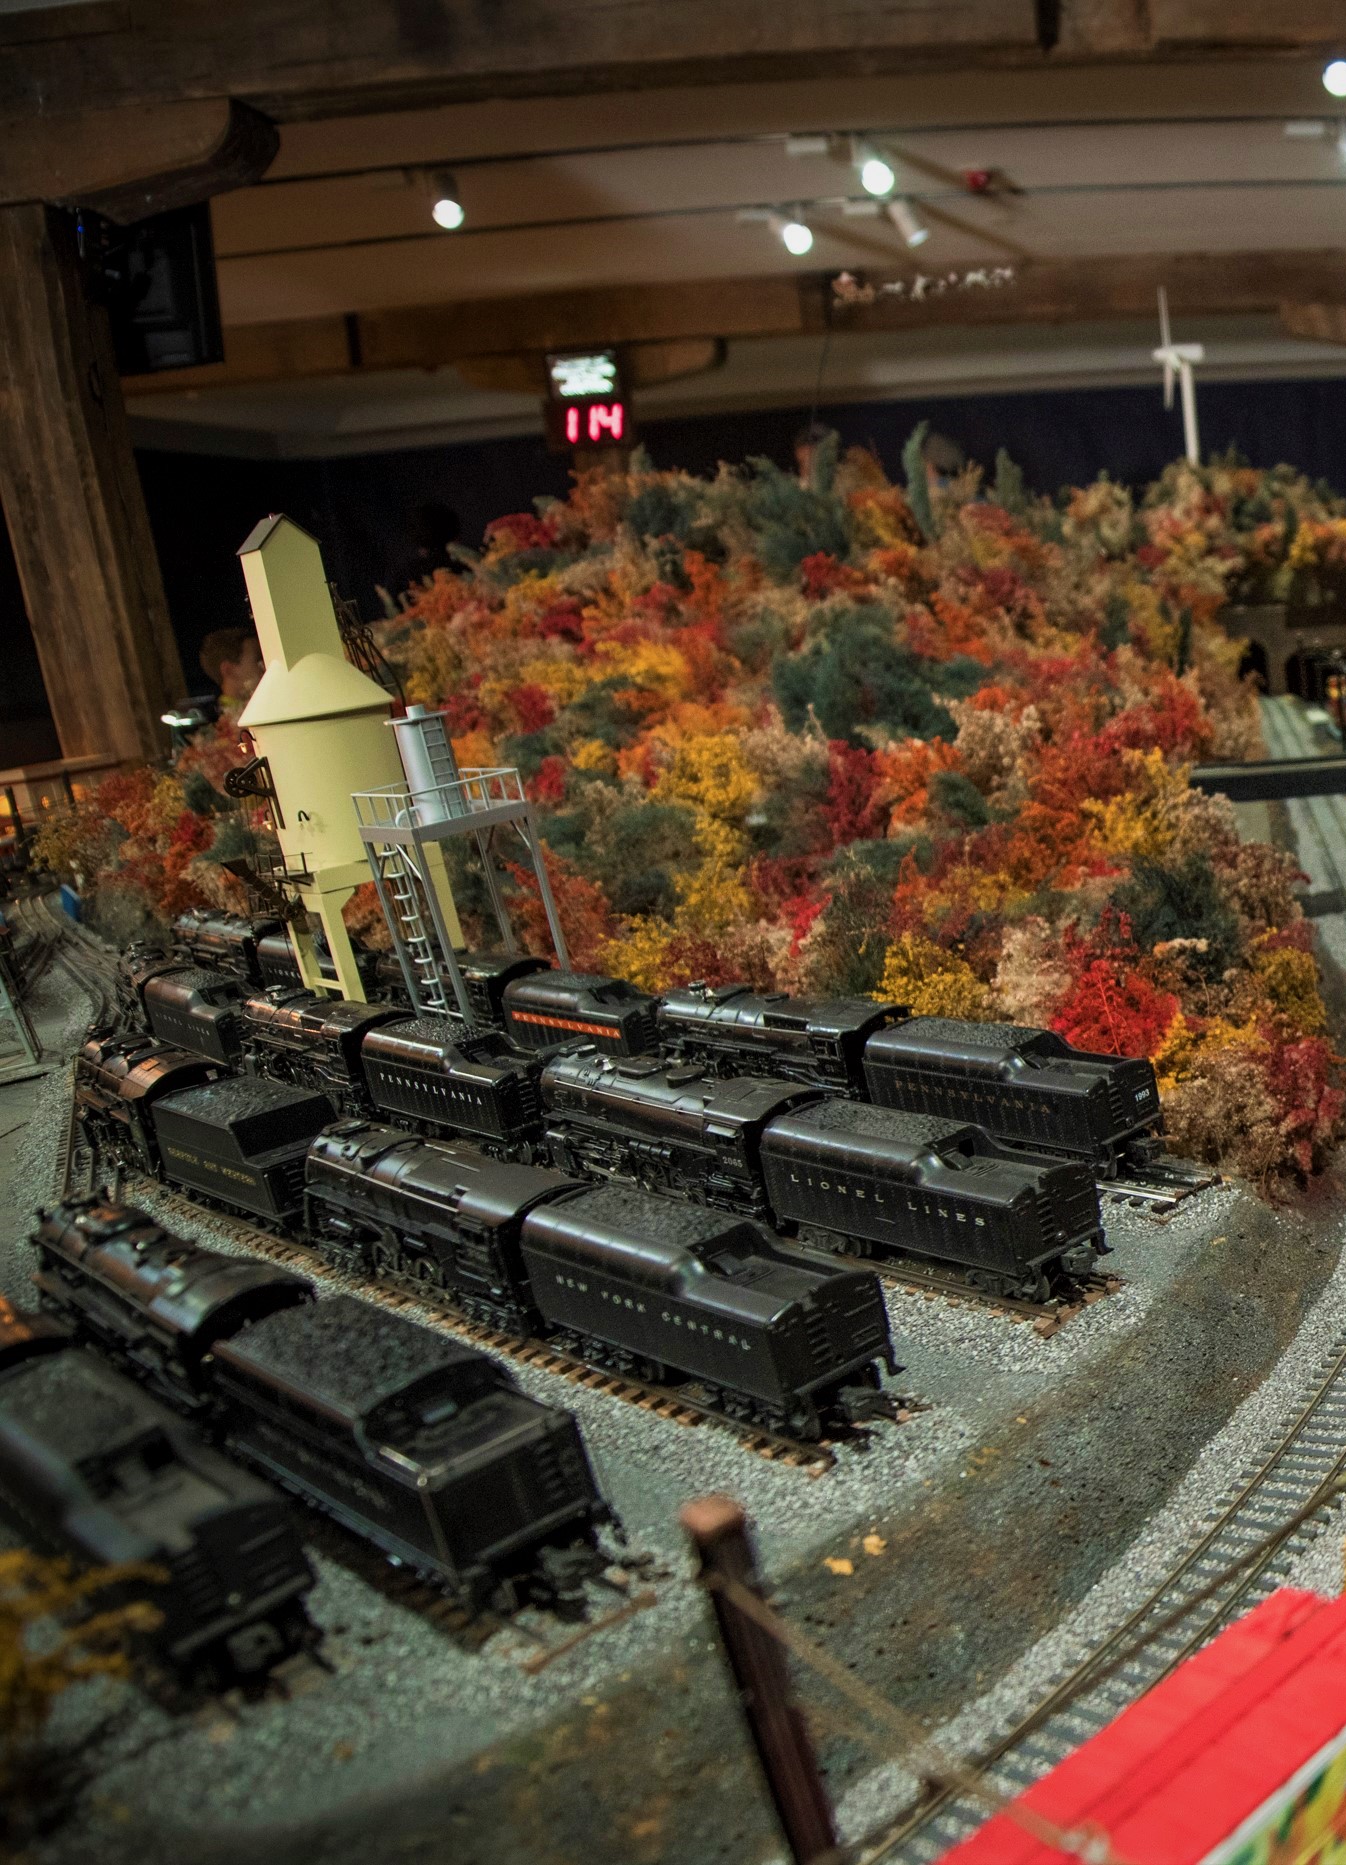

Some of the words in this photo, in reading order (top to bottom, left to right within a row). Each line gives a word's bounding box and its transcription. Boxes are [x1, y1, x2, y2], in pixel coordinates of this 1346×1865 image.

[566, 403, 623, 444] 114
[513, 1012, 620, 1038] PENNSYLVANIA
[380, 1072, 482, 1105] PENNSYLVANIA
[895, 1079, 1050, 1114] PENNSYLVANIA
[790, 1174, 884, 1203] LIONEL
[908, 1202, 985, 1226] LINES
[556, 1274, 588, 1293] NEW
[601, 1290, 647, 1314] YORK
[661, 1311, 751, 1351] CENTRAL
